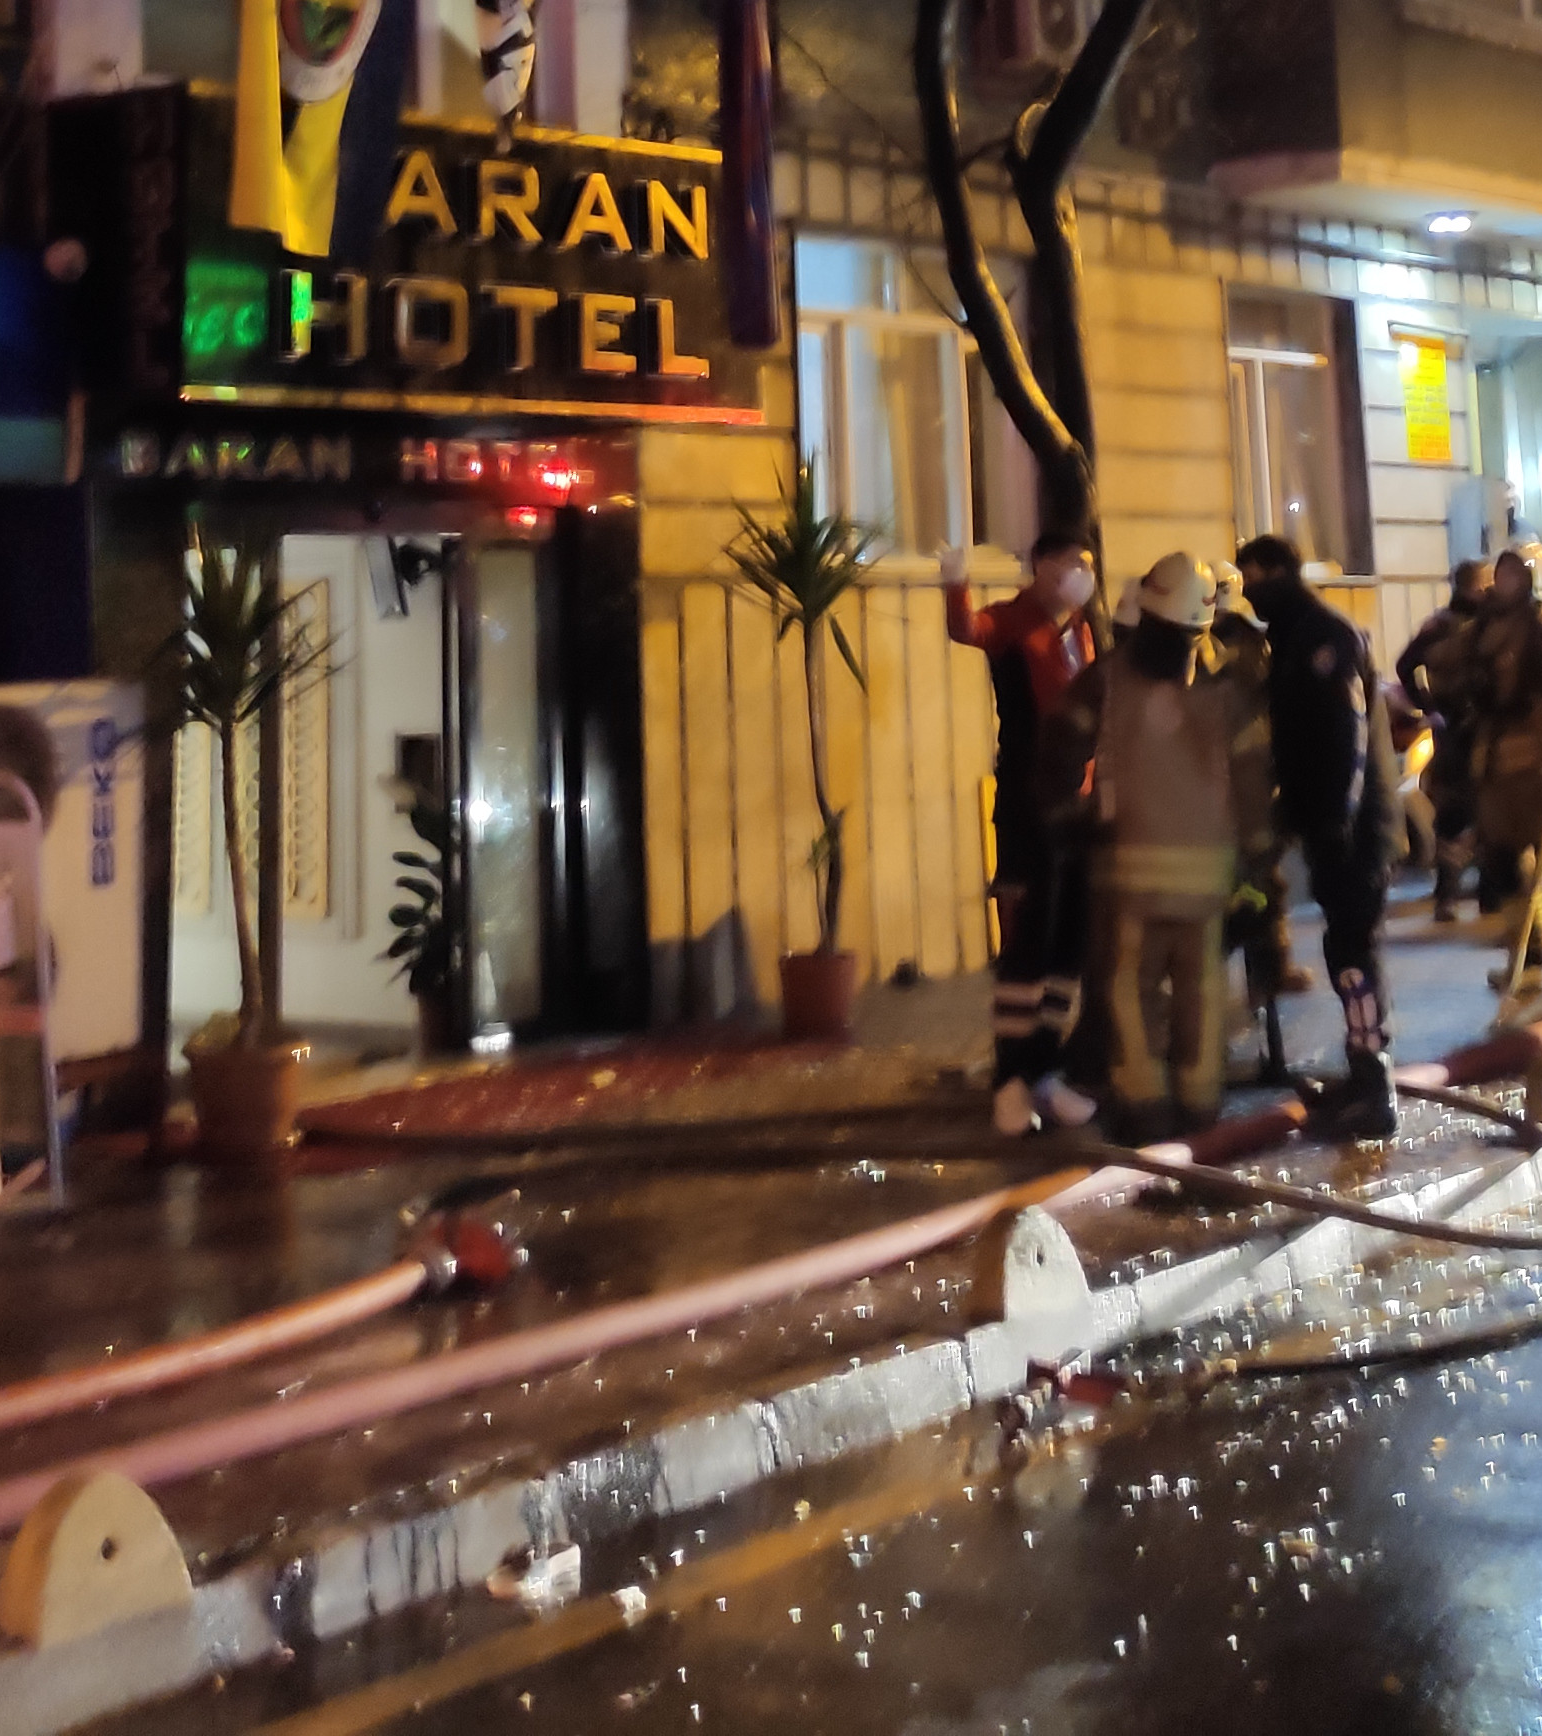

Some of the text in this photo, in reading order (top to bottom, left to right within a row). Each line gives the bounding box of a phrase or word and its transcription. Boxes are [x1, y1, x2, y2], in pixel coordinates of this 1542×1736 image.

[383, 148, 710, 262] ARAN
[278, 268, 711, 380] HOTEL
[120, 432, 352, 484] BARAN
[91, 717, 117, 886] BEKO
